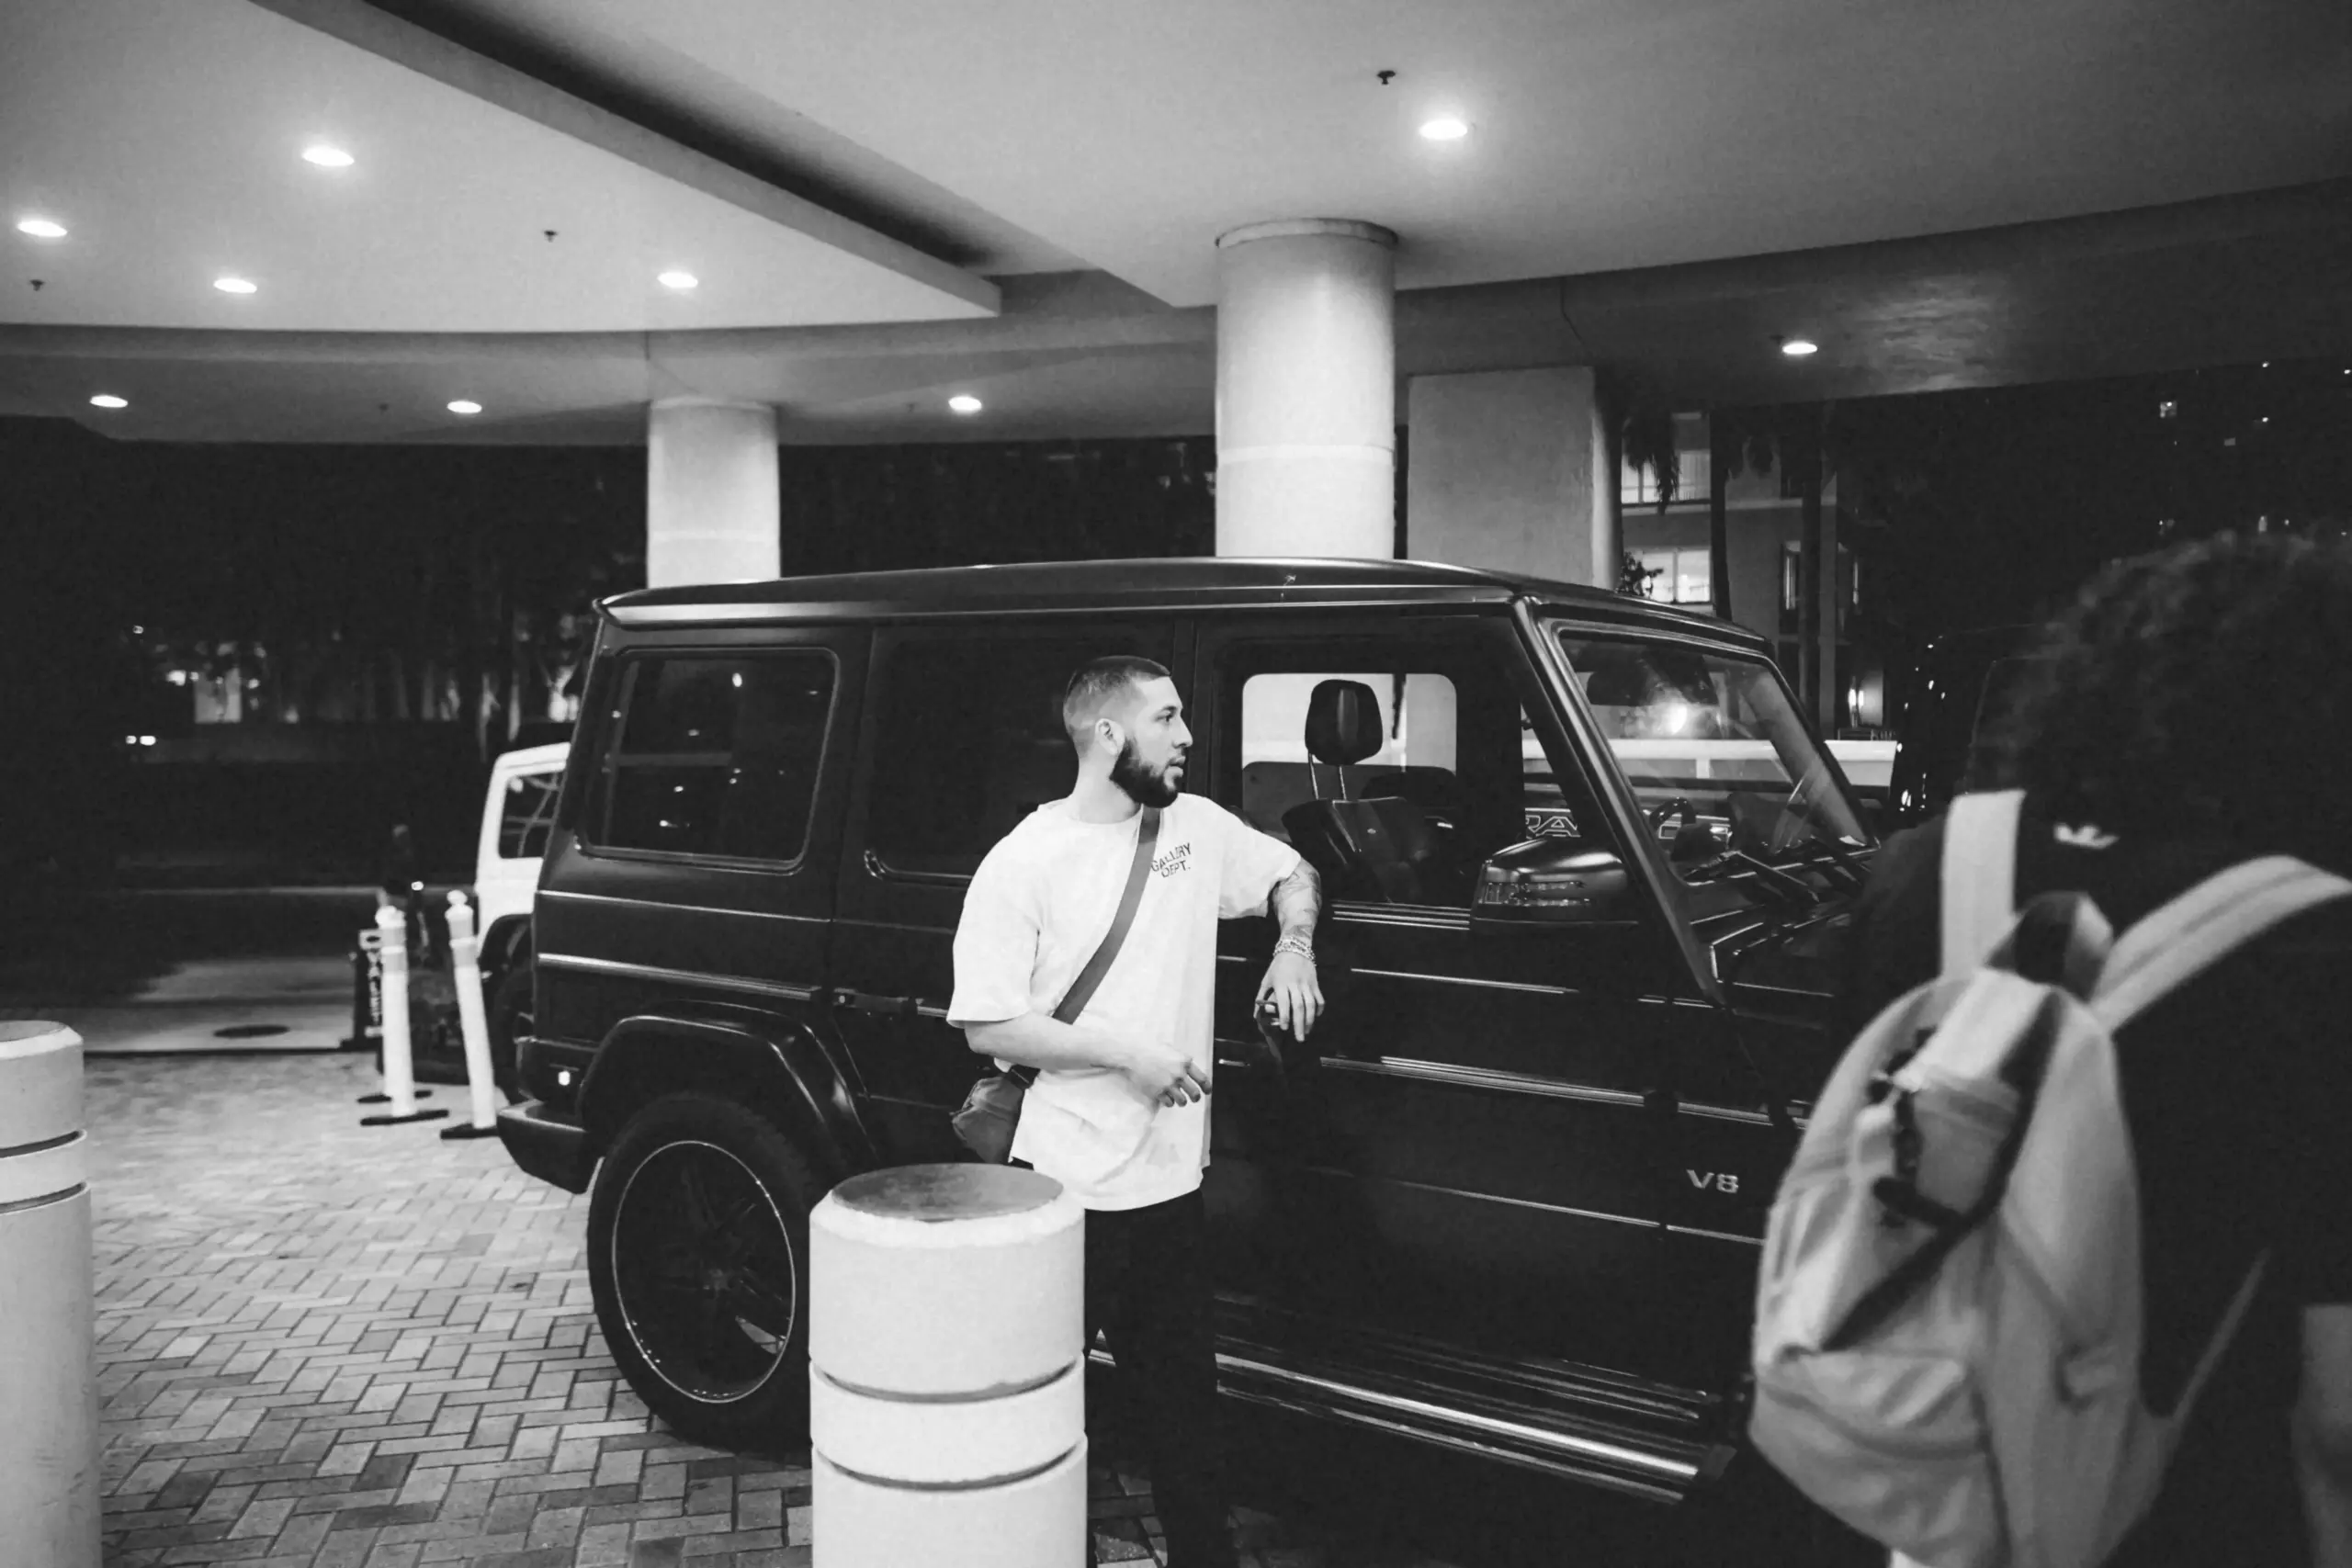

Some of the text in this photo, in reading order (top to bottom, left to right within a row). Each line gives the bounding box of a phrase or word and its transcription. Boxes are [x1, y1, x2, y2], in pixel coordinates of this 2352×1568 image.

[1150, 842, 1192, 872] GALLERY
[1161, 860, 1192, 878] DEPT.
[1686, 1168, 1739, 1194] V8
